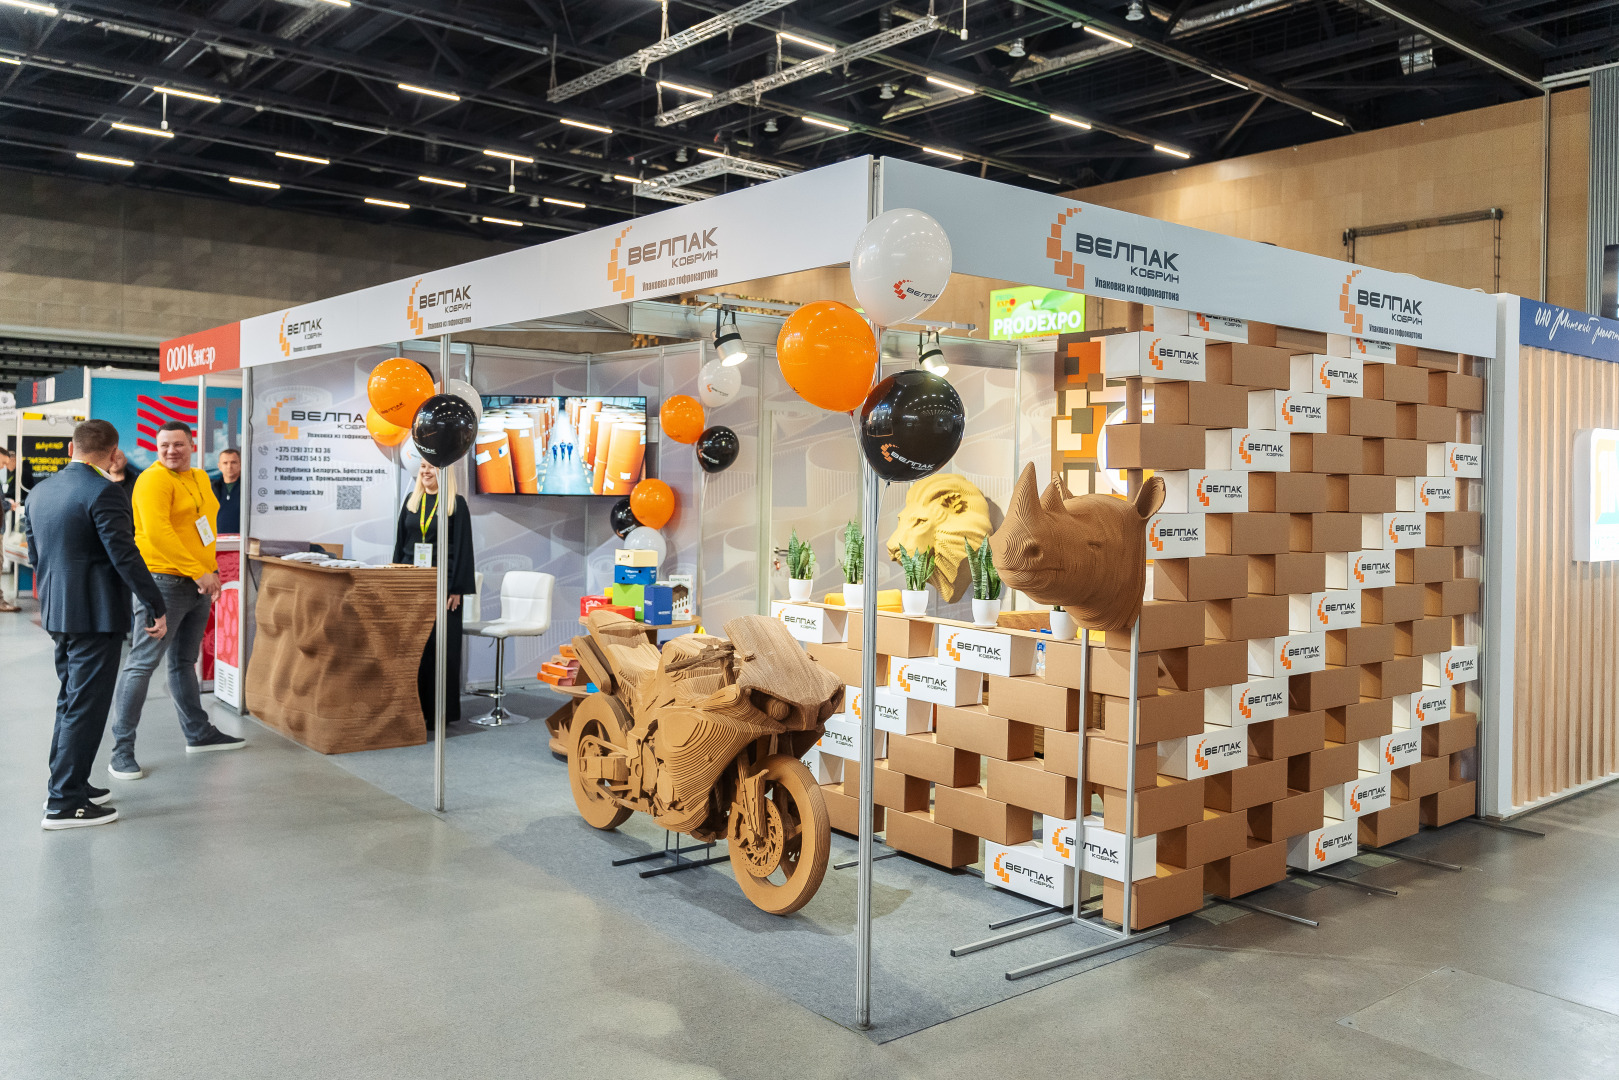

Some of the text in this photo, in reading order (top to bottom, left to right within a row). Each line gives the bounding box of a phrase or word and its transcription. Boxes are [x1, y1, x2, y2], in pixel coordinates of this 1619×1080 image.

[628, 226, 718, 265] ВЕЛПАК
[1076, 232, 1180, 272] ВЕЛПАК
[672, 249, 718, 268] КОБРИН
[1130, 265, 1180, 284] КОБРИН
[1094, 276, 1126, 294] Упаковка
[420, 285, 471, 309] ВЕЛПАК
[1358, 289, 1422, 316] ВЕЛПАК
[445, 302, 471, 313] КОБРИН
[993, 310, 1082, 337] PRODEXPO
[1392, 313, 1422, 326] КОБРИН
[287, 317, 322, 336] ВЕЛПАК
[167, 344, 186, 373] ООО
[1159, 348, 1199, 361] ВЕЛПАК
[1327, 369, 1358, 380] ВЕЛПАК
[1290, 404, 1321, 415] ВЕЛПАК
[291, 410, 365, 423] ВЕЛПА
[1248, 443, 1283, 453] ВЕЛПАК
[890, 451, 935, 470] ВЕЛПАК
[1456, 454, 1478, 462] ВЕЛПАК
[1206, 485, 1242, 494] ВЕЛПАК
[1427, 488, 1450, 496] ВЕЛПАК
[1160, 528, 1198, 537] ВЕЛПАК
[1395, 524, 1421, 532] ВЕЛПАК
[1362, 562, 1390, 571] ВЕЛПАК
[1325, 602, 1356, 612] ВЕЛПАК
[785, 616, 816, 626] ВЕЛПАК
[957, 641, 1001, 657] ВЕЛПАК
[1289, 646, 1320, 657] ВЕЛПАК
[1451, 659, 1474, 670] ВЕЛПАК
[908, 673, 947, 687] ВЕЛПАК
[1248, 692, 1282, 705] ВЕЛПАК
[1422, 699, 1446, 710] ВЕЛПАК
[825, 730, 853, 744] ЕЛПАК
[1204, 740, 1242, 756] ВЕЛПАК
[1392, 741, 1417, 753] ВЕЛПАК
[1357, 785, 1386, 800] ВЕЛПАК
[1322, 833, 1352, 849] ВЕЛПАК
[1065, 836, 1118, 860] ВЛПАК
[1091, 852, 1119, 865] КОБРИН
[1005, 861, 1054, 884] ВЕЛПАК
[1029, 877, 1055, 890] КОБРИН
